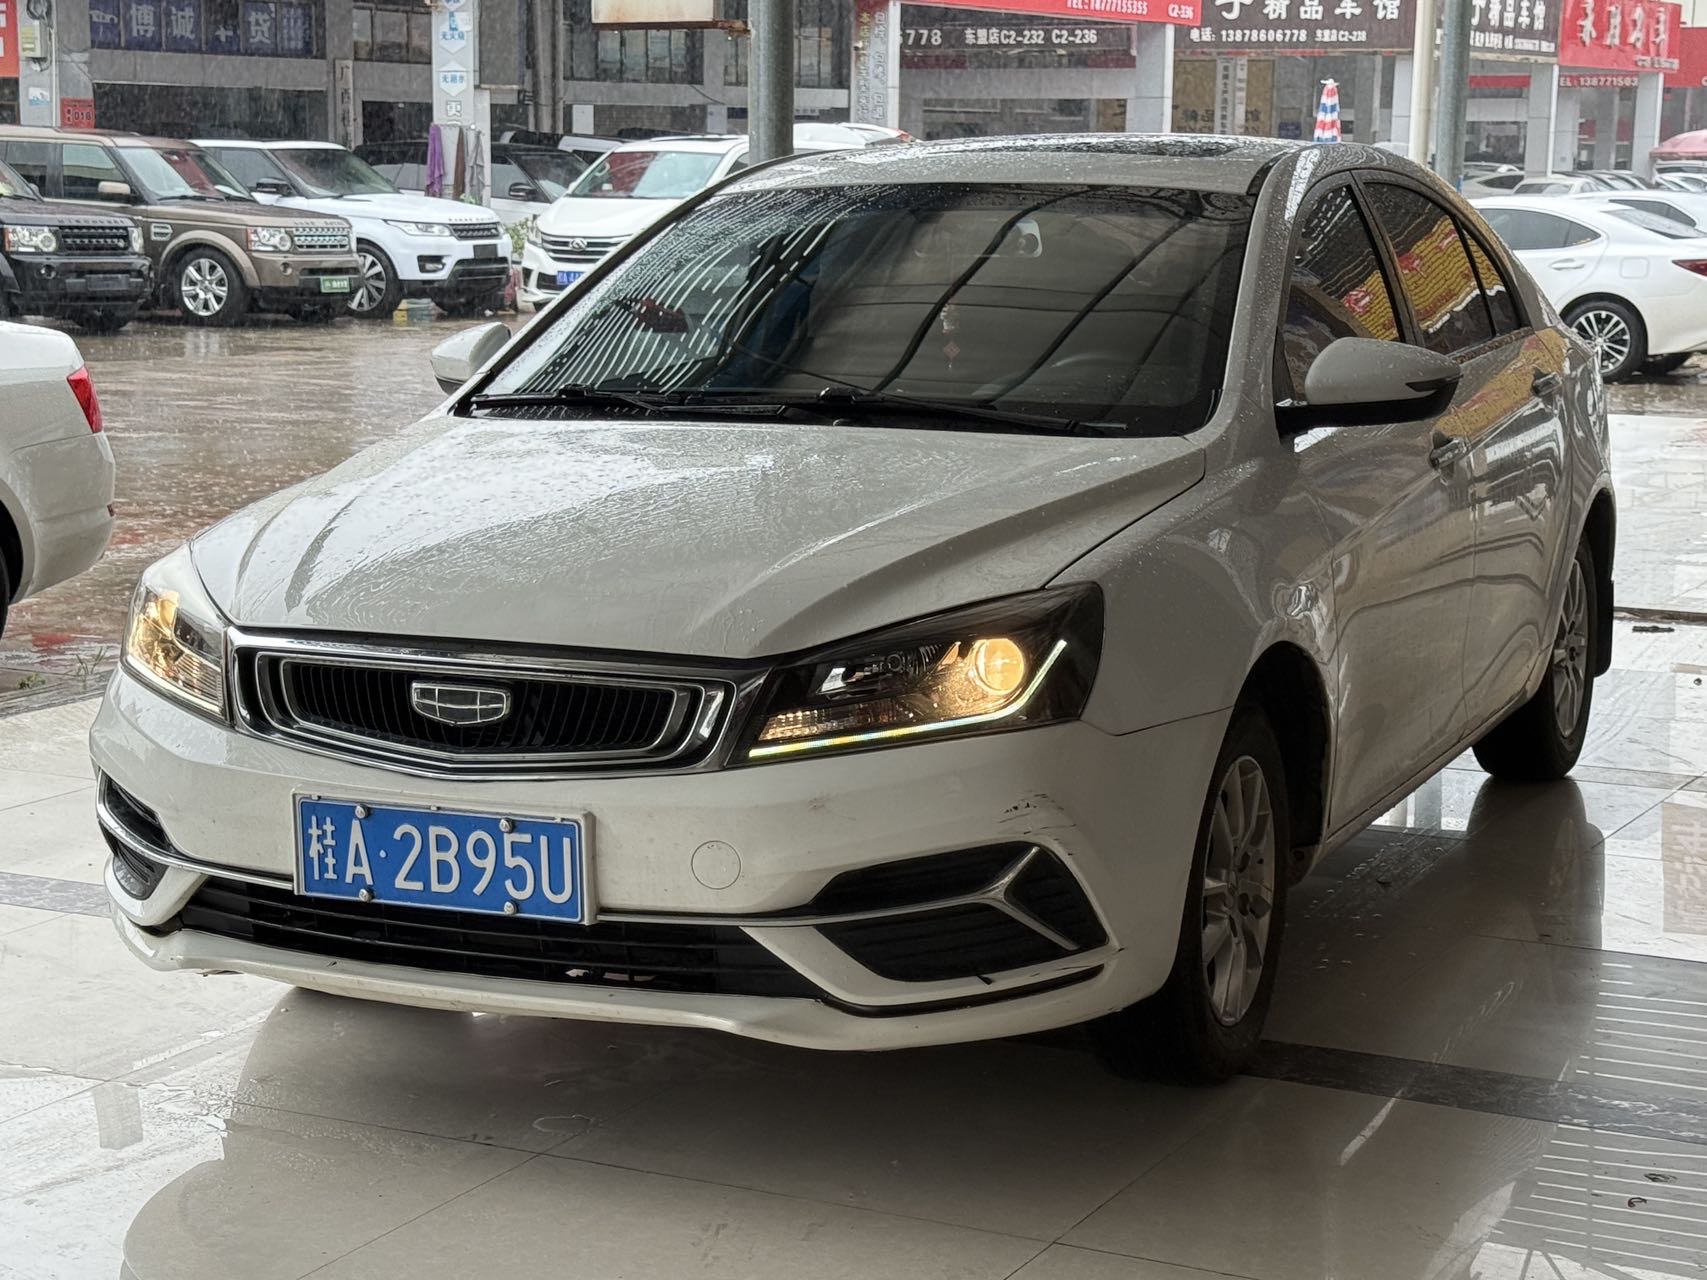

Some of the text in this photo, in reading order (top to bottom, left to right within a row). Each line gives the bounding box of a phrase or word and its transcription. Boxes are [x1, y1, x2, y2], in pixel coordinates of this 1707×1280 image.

[1051, 29, 1097, 44] C2-236
[1220, 29, 1307, 42] 13878606778
[308, 815, 574, 904] 桂A·2B95U
